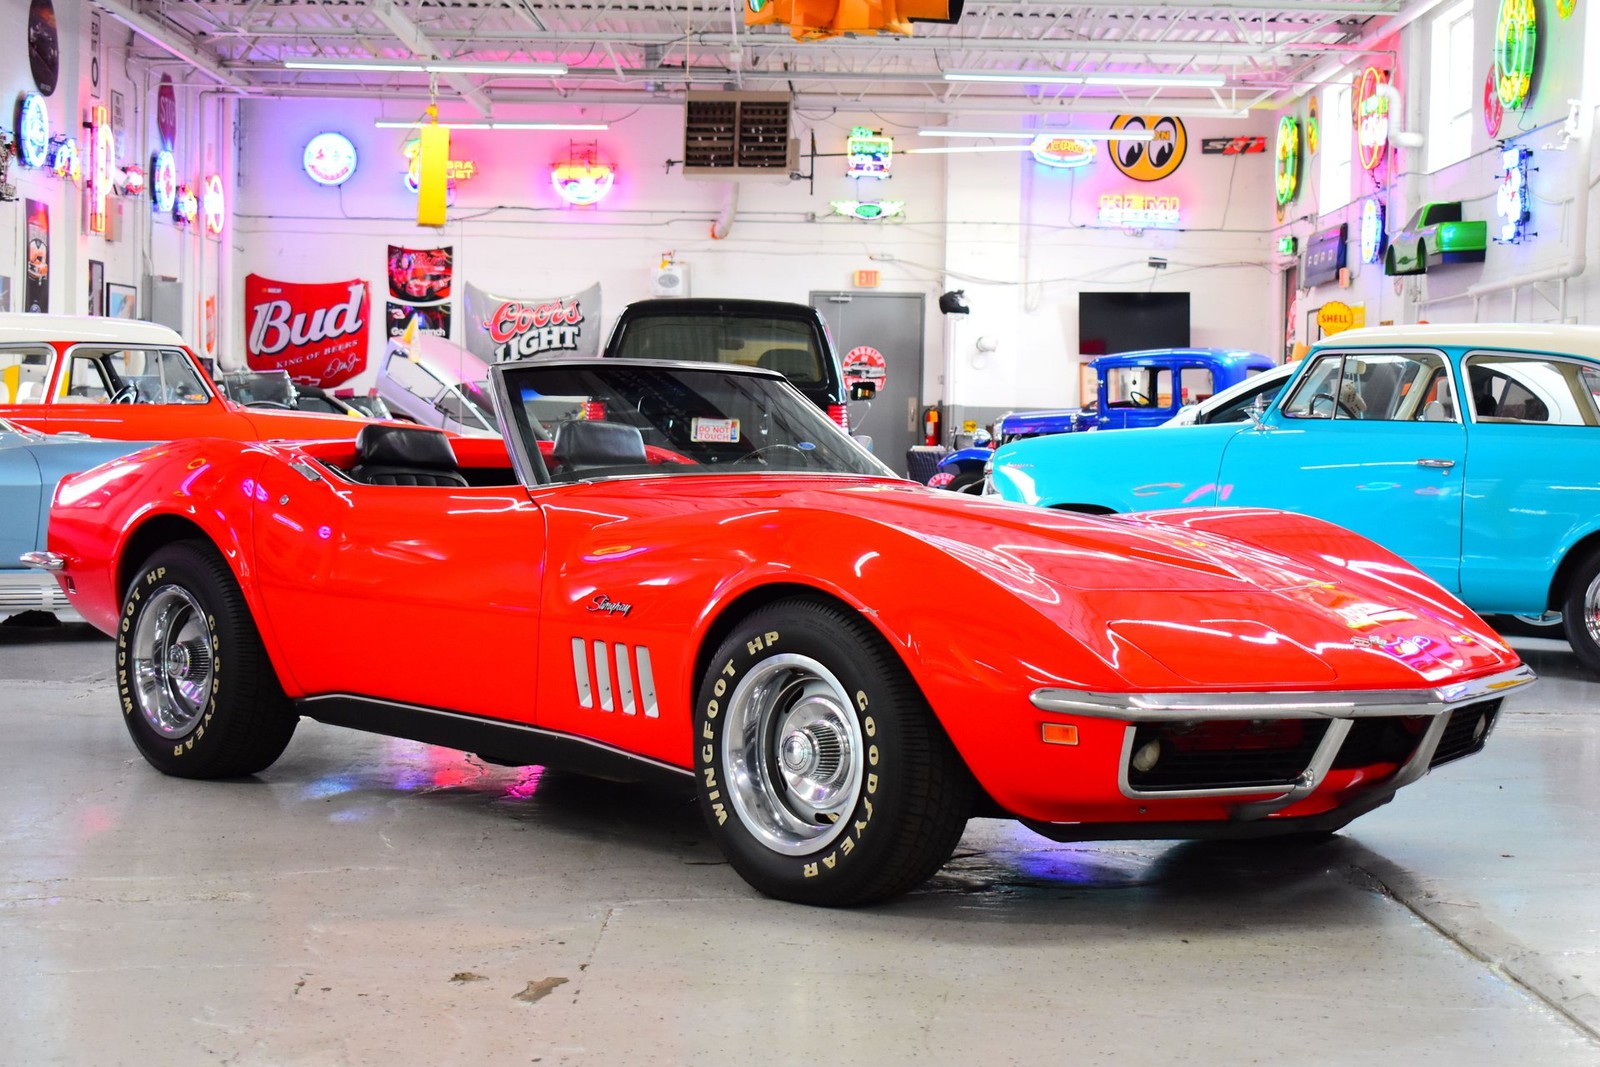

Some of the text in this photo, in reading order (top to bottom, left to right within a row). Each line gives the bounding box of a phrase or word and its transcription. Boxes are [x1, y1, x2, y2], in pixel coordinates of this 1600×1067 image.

[447, 160, 473, 170] BRA
[1308, 248, 1334, 266] FORD
[858, 270, 878, 287] EXIT
[248, 283, 364, 356] Bud
[483, 298, 584, 344] Coors
[1321, 314, 1348, 324] SHELL
[276, 340, 358, 369] KING OF BEERS
[494, 325, 581, 364] LIGHT
[586, 594, 632, 617] Stingray
[119, 566, 167, 714] WINGFOOT HP
[173, 614, 221, 757] GOODYEAR
[702, 630, 780, 826] WINGFOOT HP
[803, 690, 880, 878] GOODYEAR
